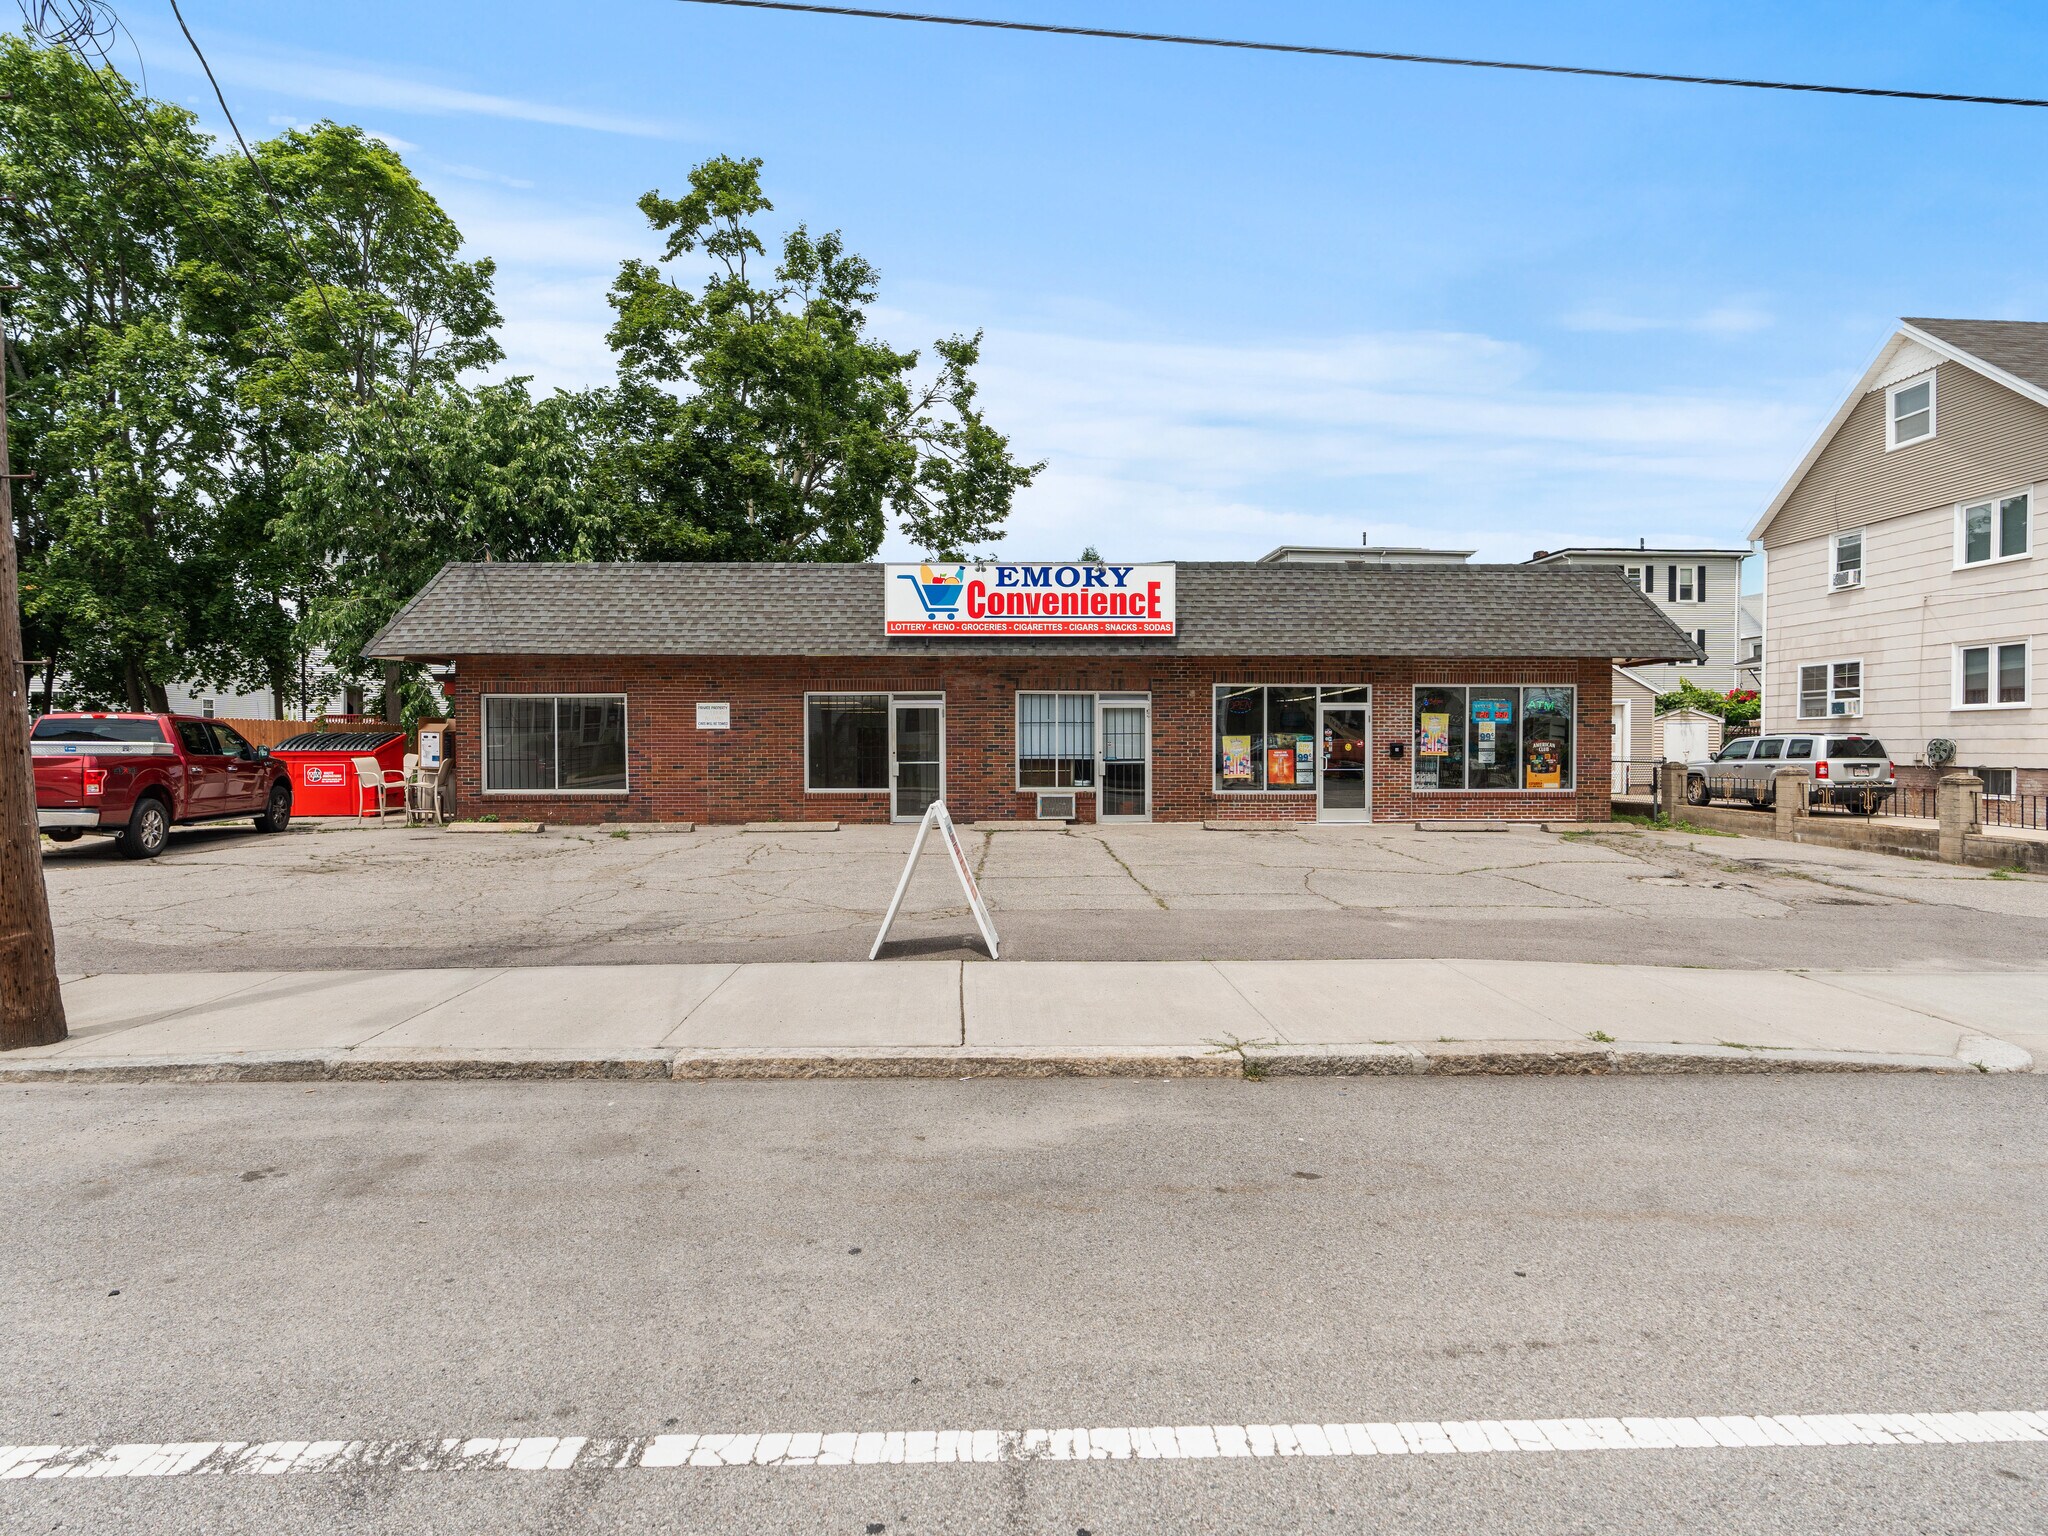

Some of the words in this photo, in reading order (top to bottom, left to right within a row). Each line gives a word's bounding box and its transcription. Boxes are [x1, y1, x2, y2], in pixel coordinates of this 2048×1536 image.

[995, 566, 1134, 588] EMORY
[967, 580, 1161, 619] ConveniencE
[890, 623, 926, 631] LOTTERY
[932, 623, 955, 631] KENO
[961, 623, 1007, 631] GROCERIES
[1013, 623, 1063, 631] CIGARETTES
[1069, 623, 1099, 631] CIGARS
[1105, 623, 1138, 631] SNACKS
[1144, 623, 1171, 631] SODAS
[1527, 700, 1555, 711] ATM
